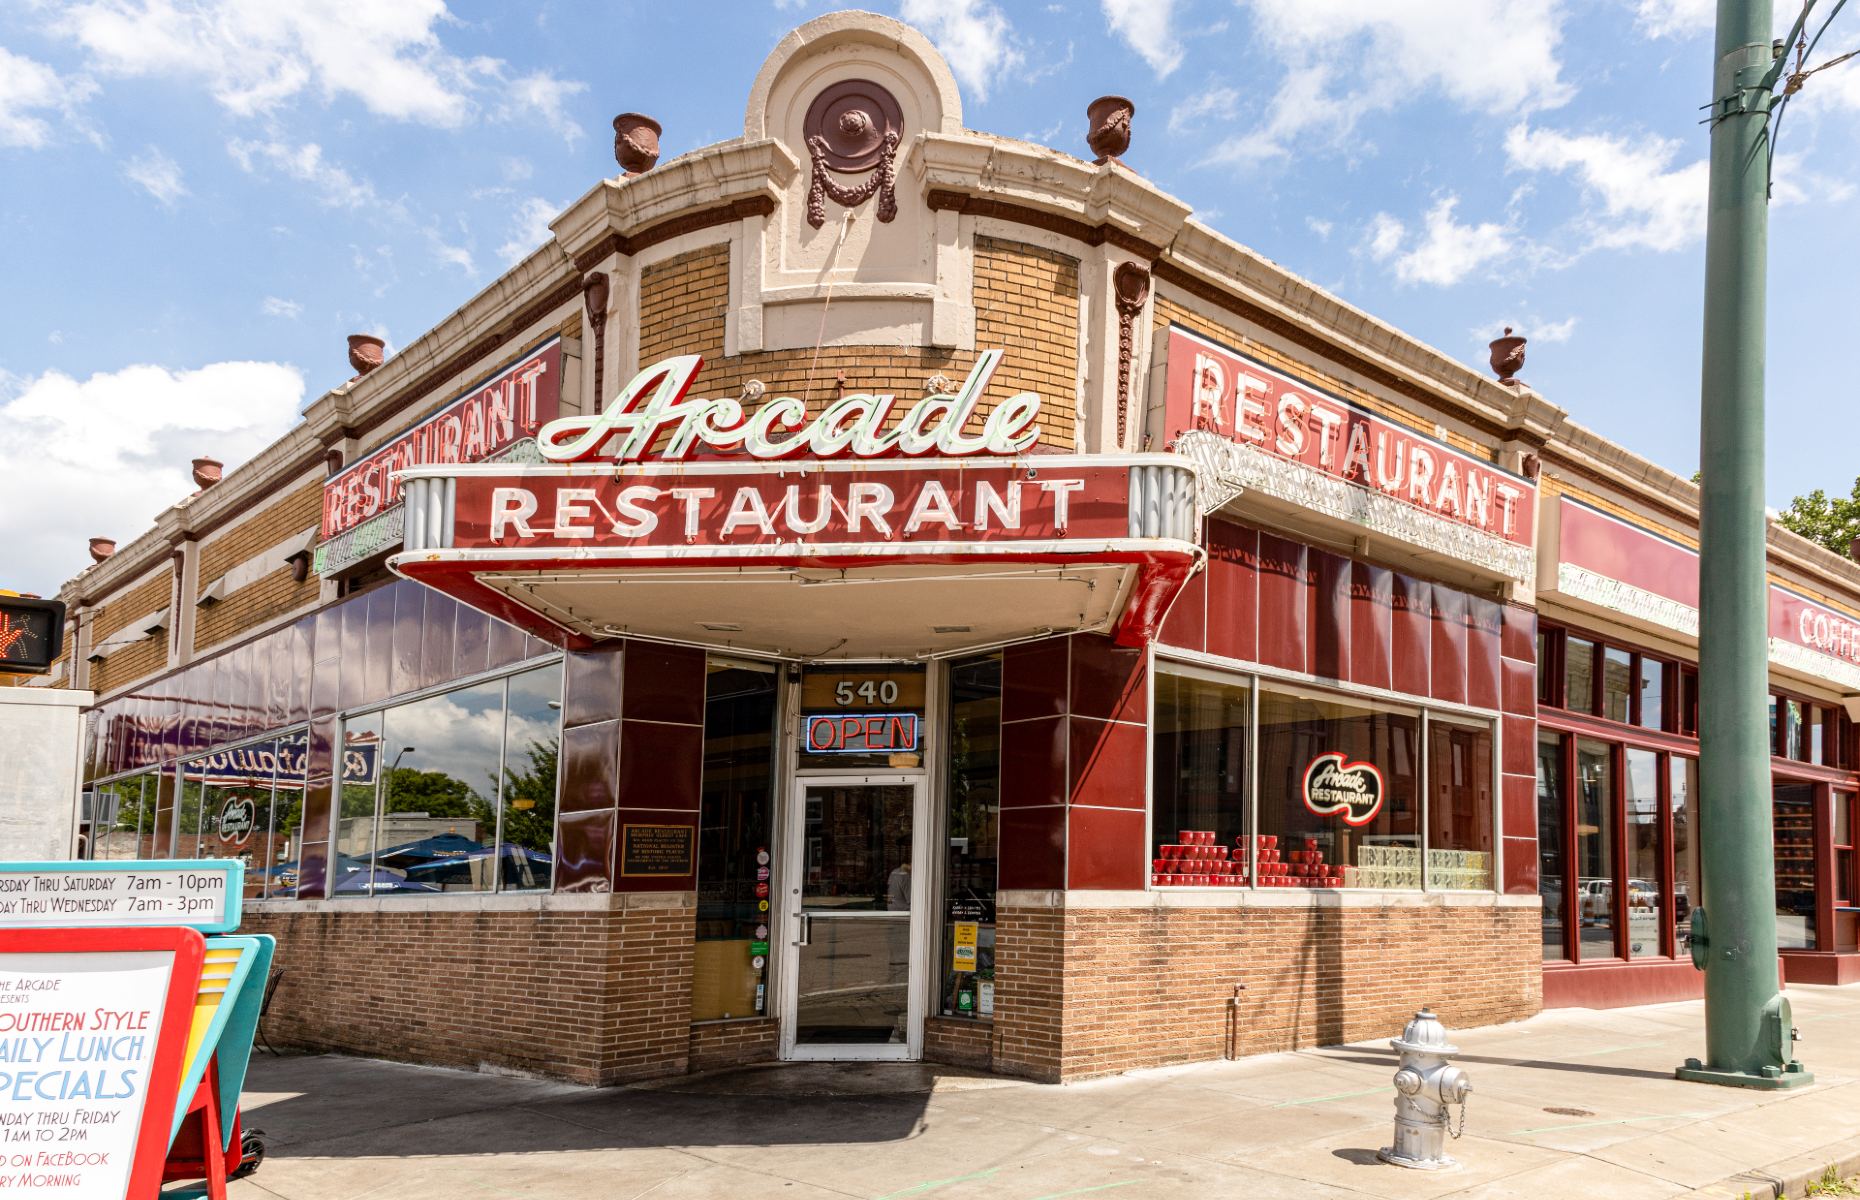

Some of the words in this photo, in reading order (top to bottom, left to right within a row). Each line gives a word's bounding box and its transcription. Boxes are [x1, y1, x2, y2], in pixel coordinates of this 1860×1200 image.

[538, 349, 1041, 461] Arcade
[1193, 350, 1524, 538] RESTAURANT
[490, 479, 1085, 542] RESTAURANT
[835, 680, 898, 705] 540
[810, 717, 914, 749] OPEN
[1313, 764, 1366, 793] Arcade
[1311, 788, 1375, 805] RESTAURANT
[127, 875, 161, 890] 7am
[178, 874, 223, 893] 10pm
[128, 896, 162, 912] 7am
[177, 895, 214, 914] 3pm
[0, 994, 30, 1004] ESENTS
